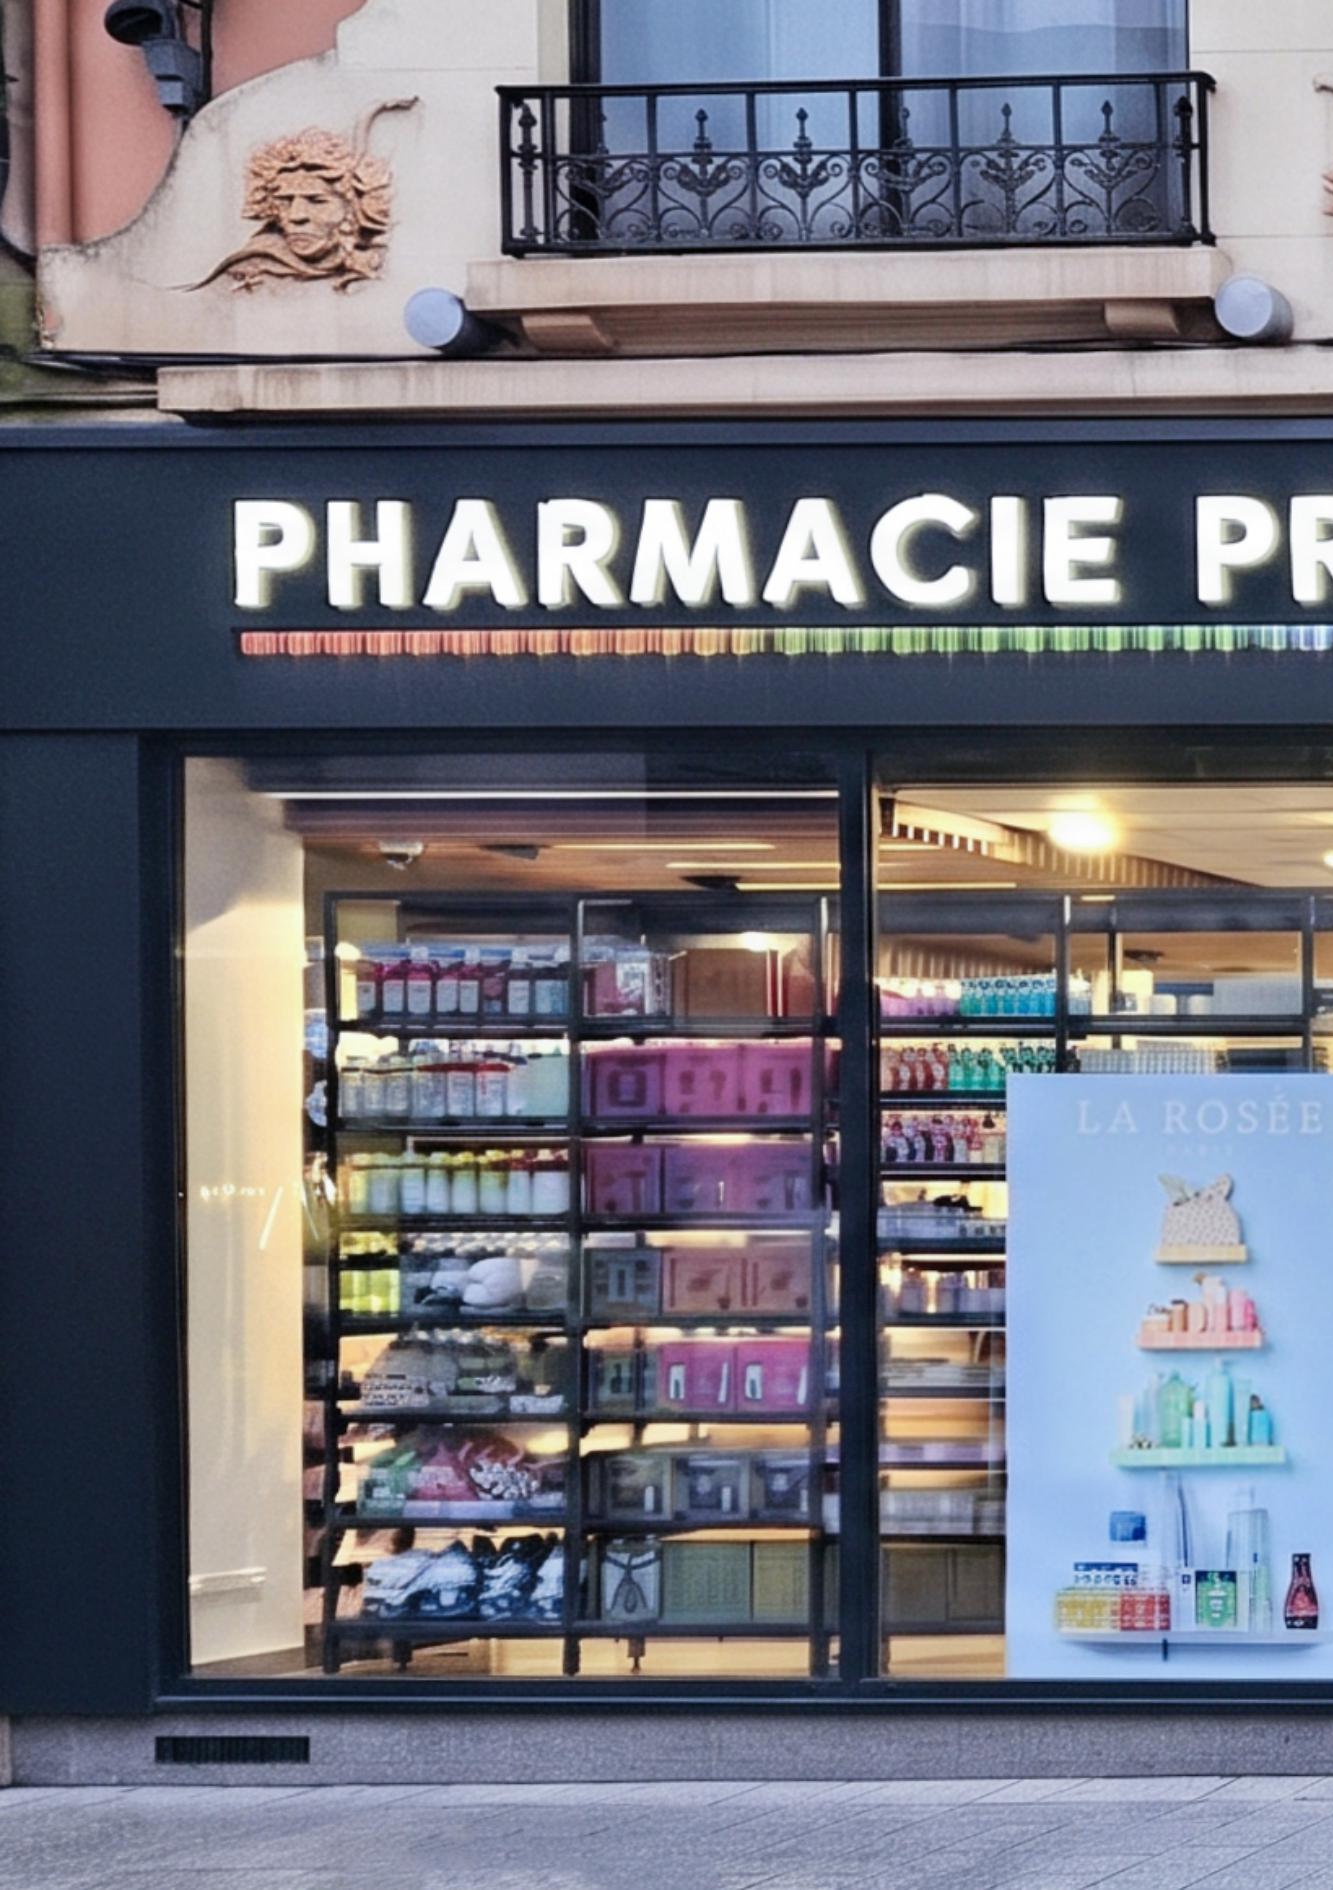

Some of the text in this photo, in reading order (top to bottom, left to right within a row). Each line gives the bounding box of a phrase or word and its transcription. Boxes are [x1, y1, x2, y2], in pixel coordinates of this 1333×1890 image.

[233, 494, 1122, 610] PHARMACIE
[1076, 1088, 1325, 1135] LA ROSÉE
